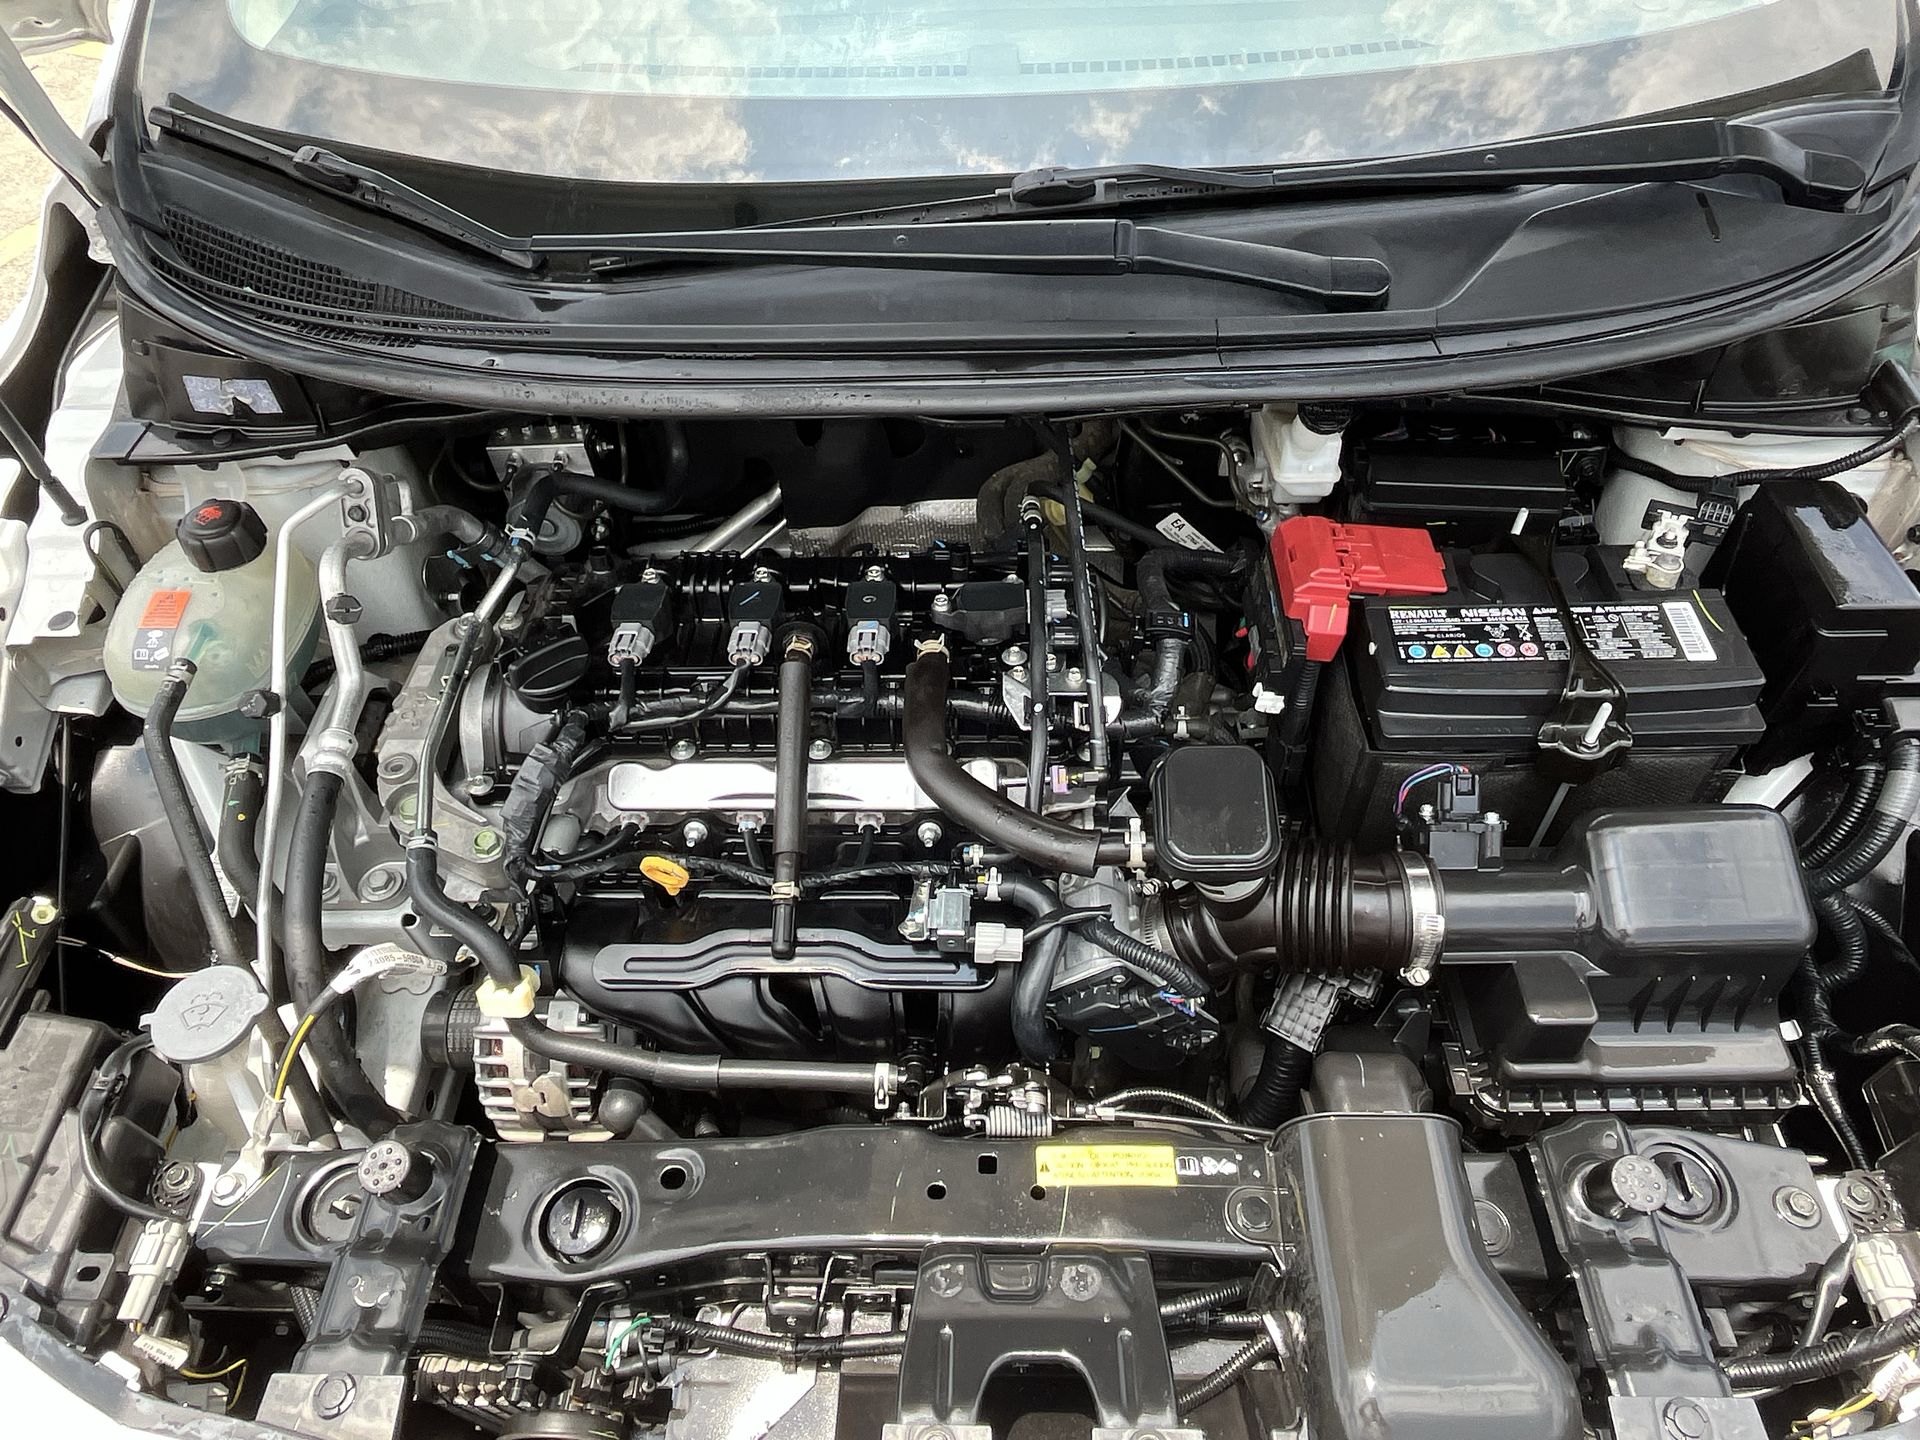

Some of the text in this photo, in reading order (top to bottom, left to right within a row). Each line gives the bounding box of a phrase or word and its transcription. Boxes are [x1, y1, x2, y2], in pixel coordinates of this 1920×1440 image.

[1170, 518, 1186, 531] EA
[1389, 607, 1526, 619] RENAULT NISSAN
